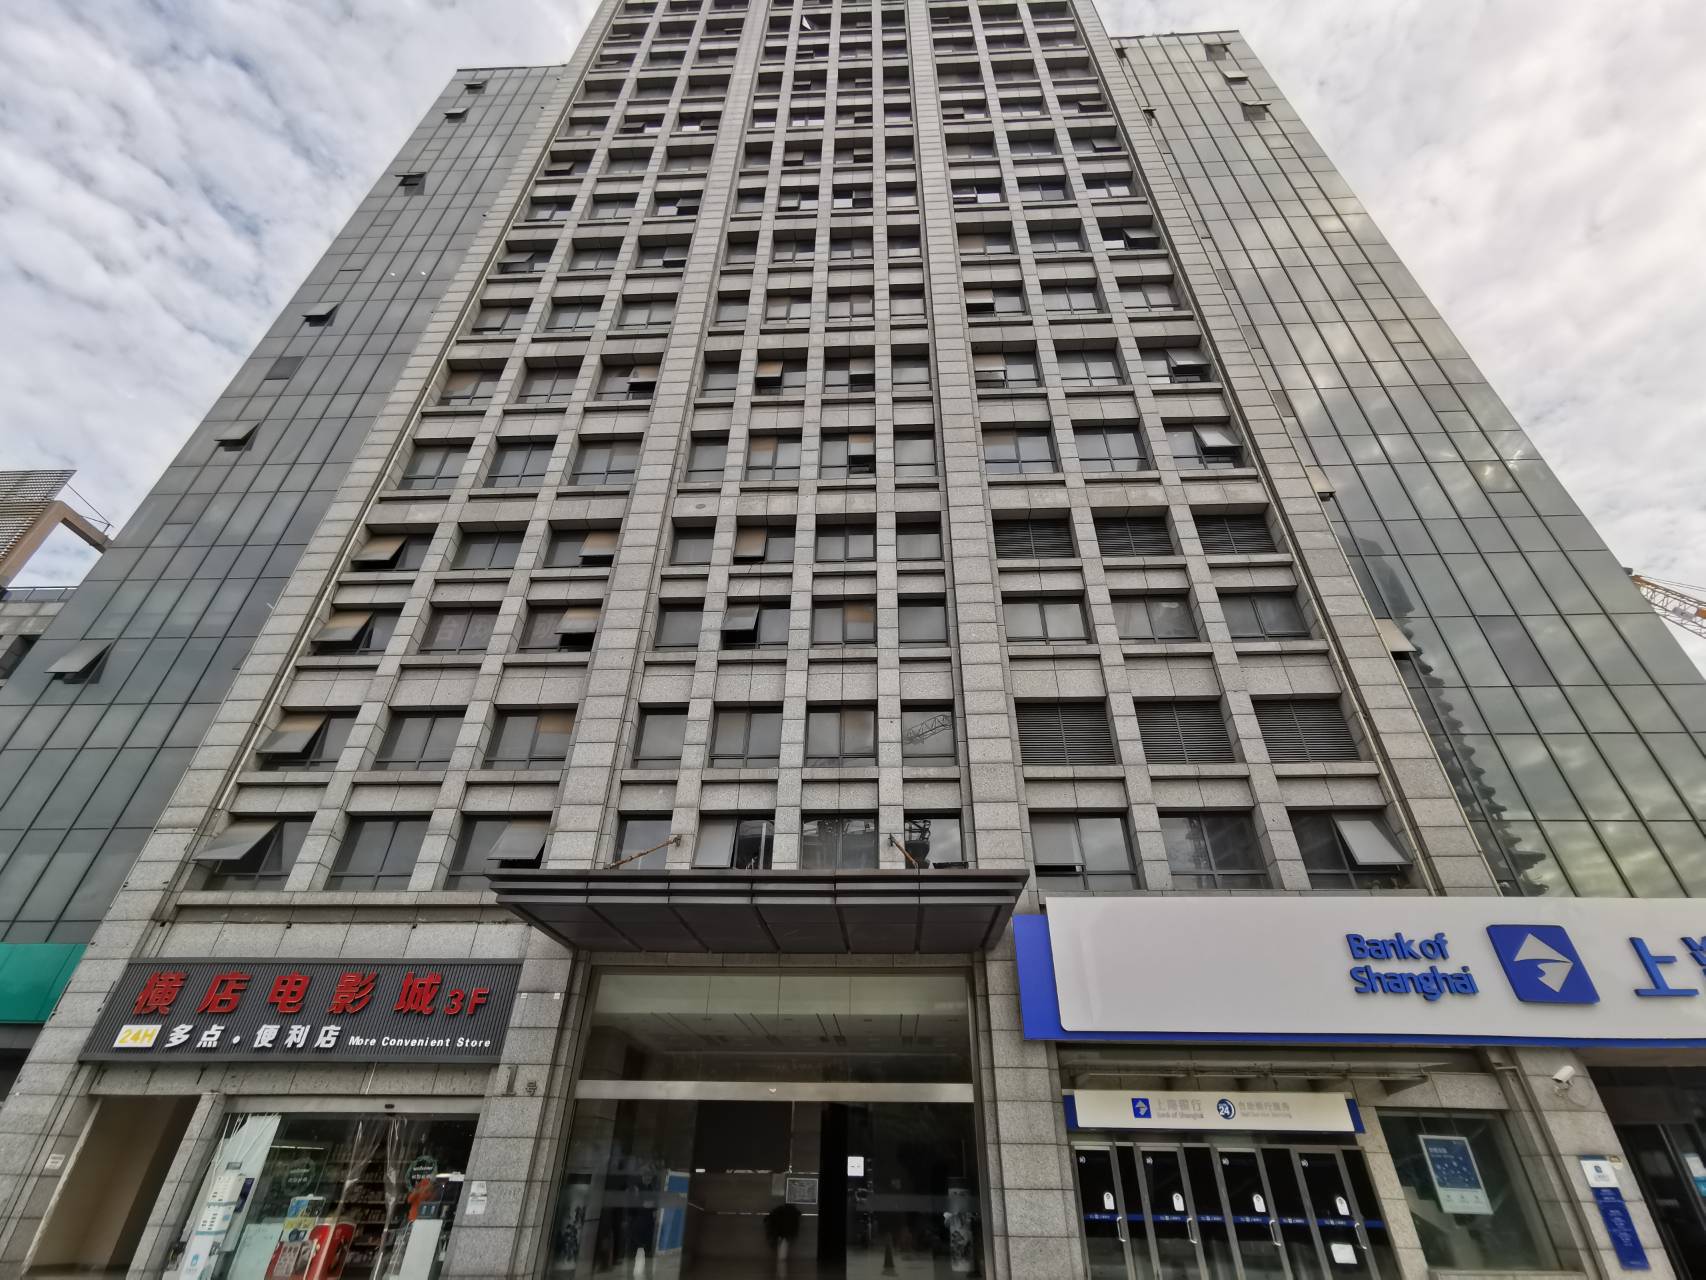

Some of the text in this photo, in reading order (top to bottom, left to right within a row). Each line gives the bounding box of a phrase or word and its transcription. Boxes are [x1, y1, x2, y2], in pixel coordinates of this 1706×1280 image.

[1346, 932, 1450, 960] Bank of
[132, 971, 490, 1015] 横店电影城 3F
[1350, 965, 1480, 1001] Shanghai
[116, 1026, 159, 1046] 24H
[349, 1035, 377, 1047] More
[382, 1036, 451, 1047] Convenient
[456, 1037, 491, 1048] Store
